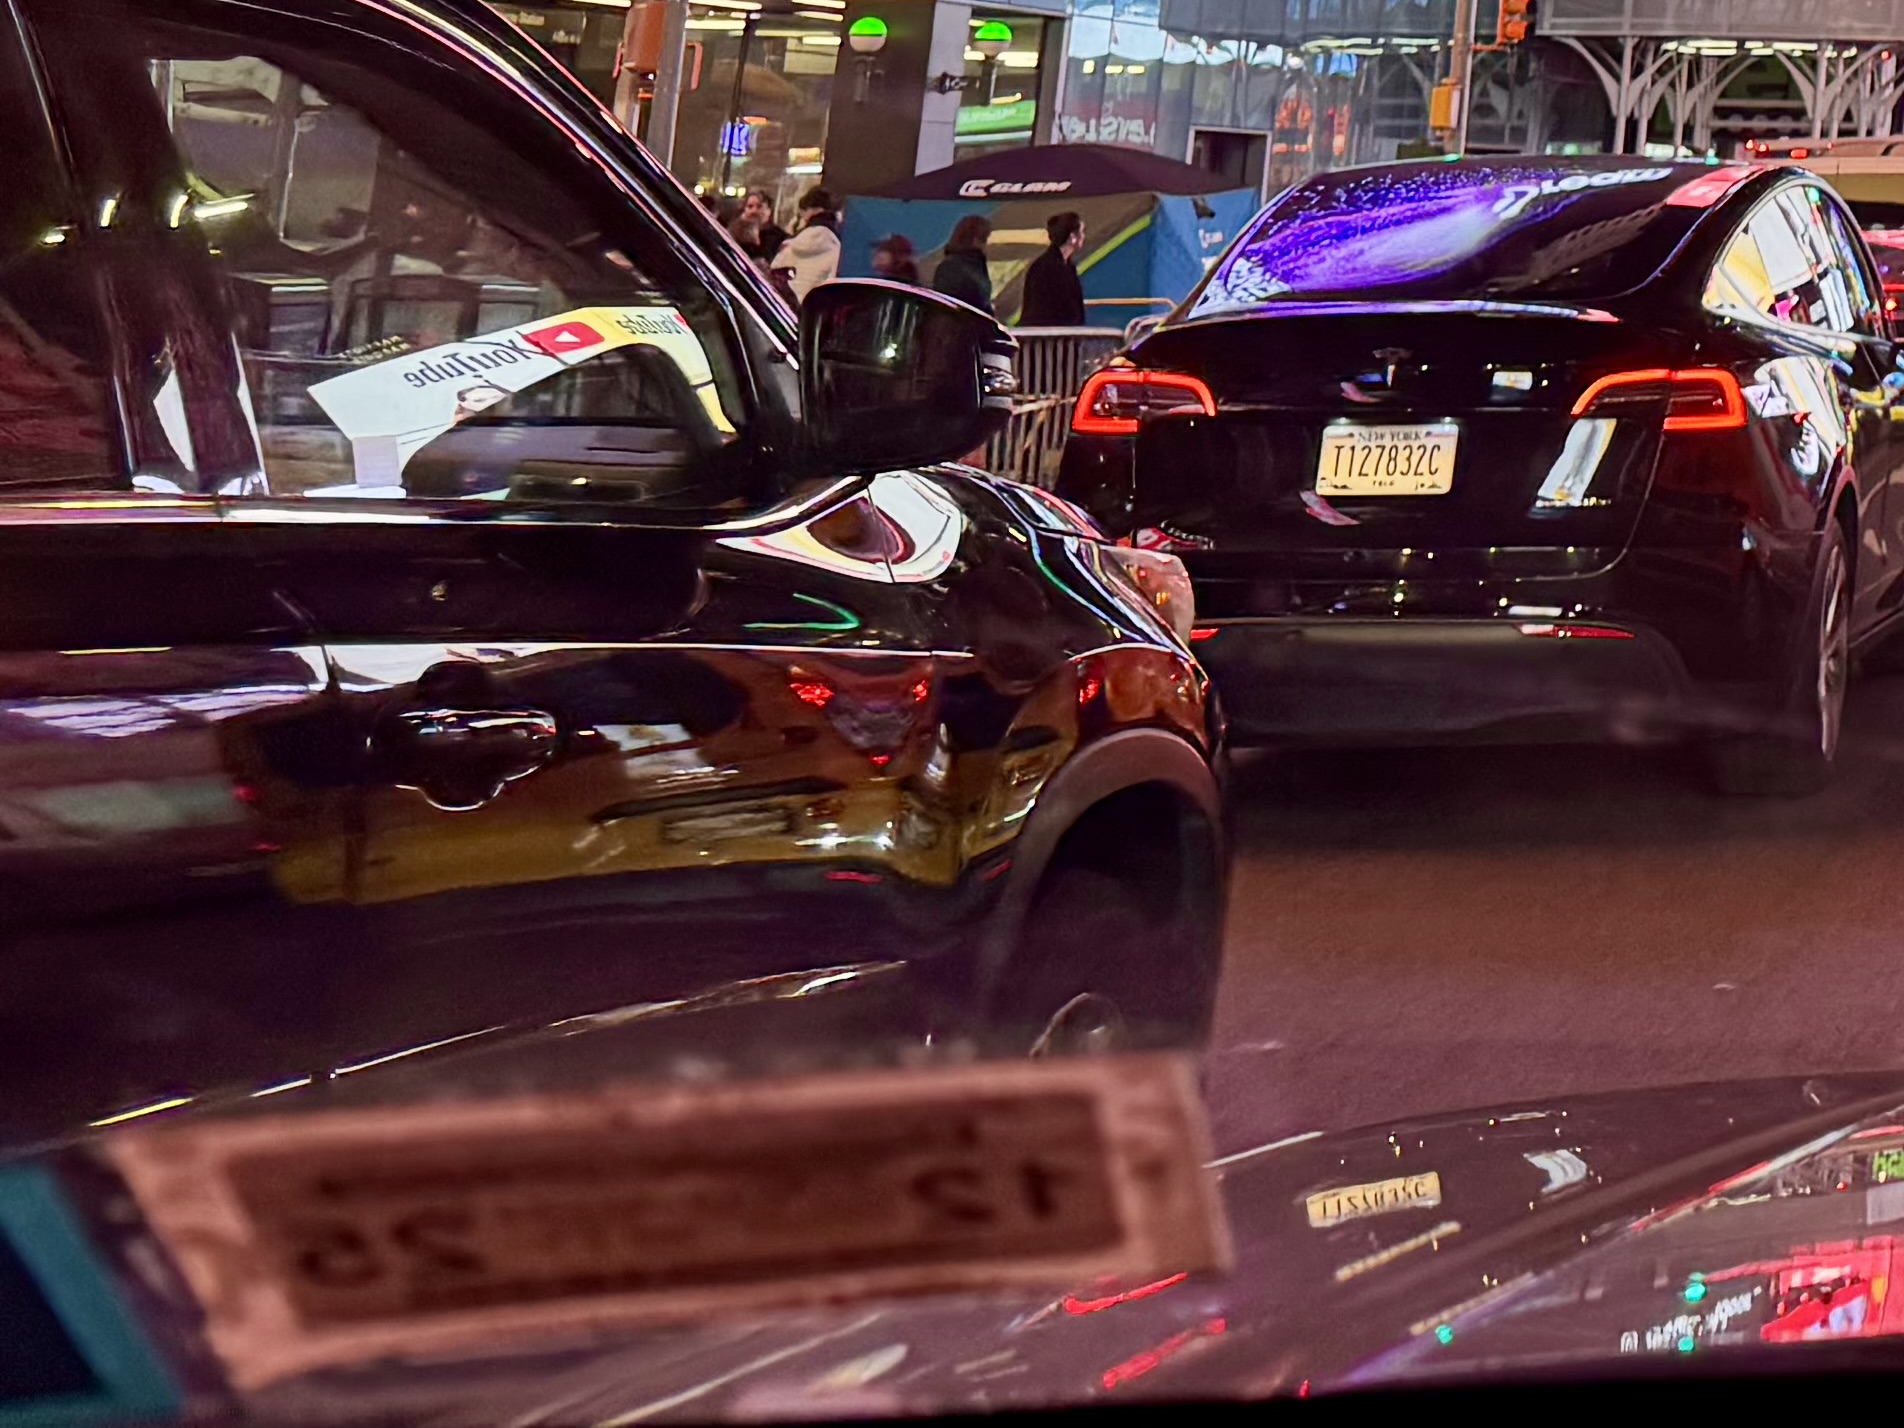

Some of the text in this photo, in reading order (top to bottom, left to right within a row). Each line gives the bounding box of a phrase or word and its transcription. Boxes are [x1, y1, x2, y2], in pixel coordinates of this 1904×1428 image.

[1357, 429, 1422, 443] NEW YORK
[1333, 444, 1442, 478] T127832C
